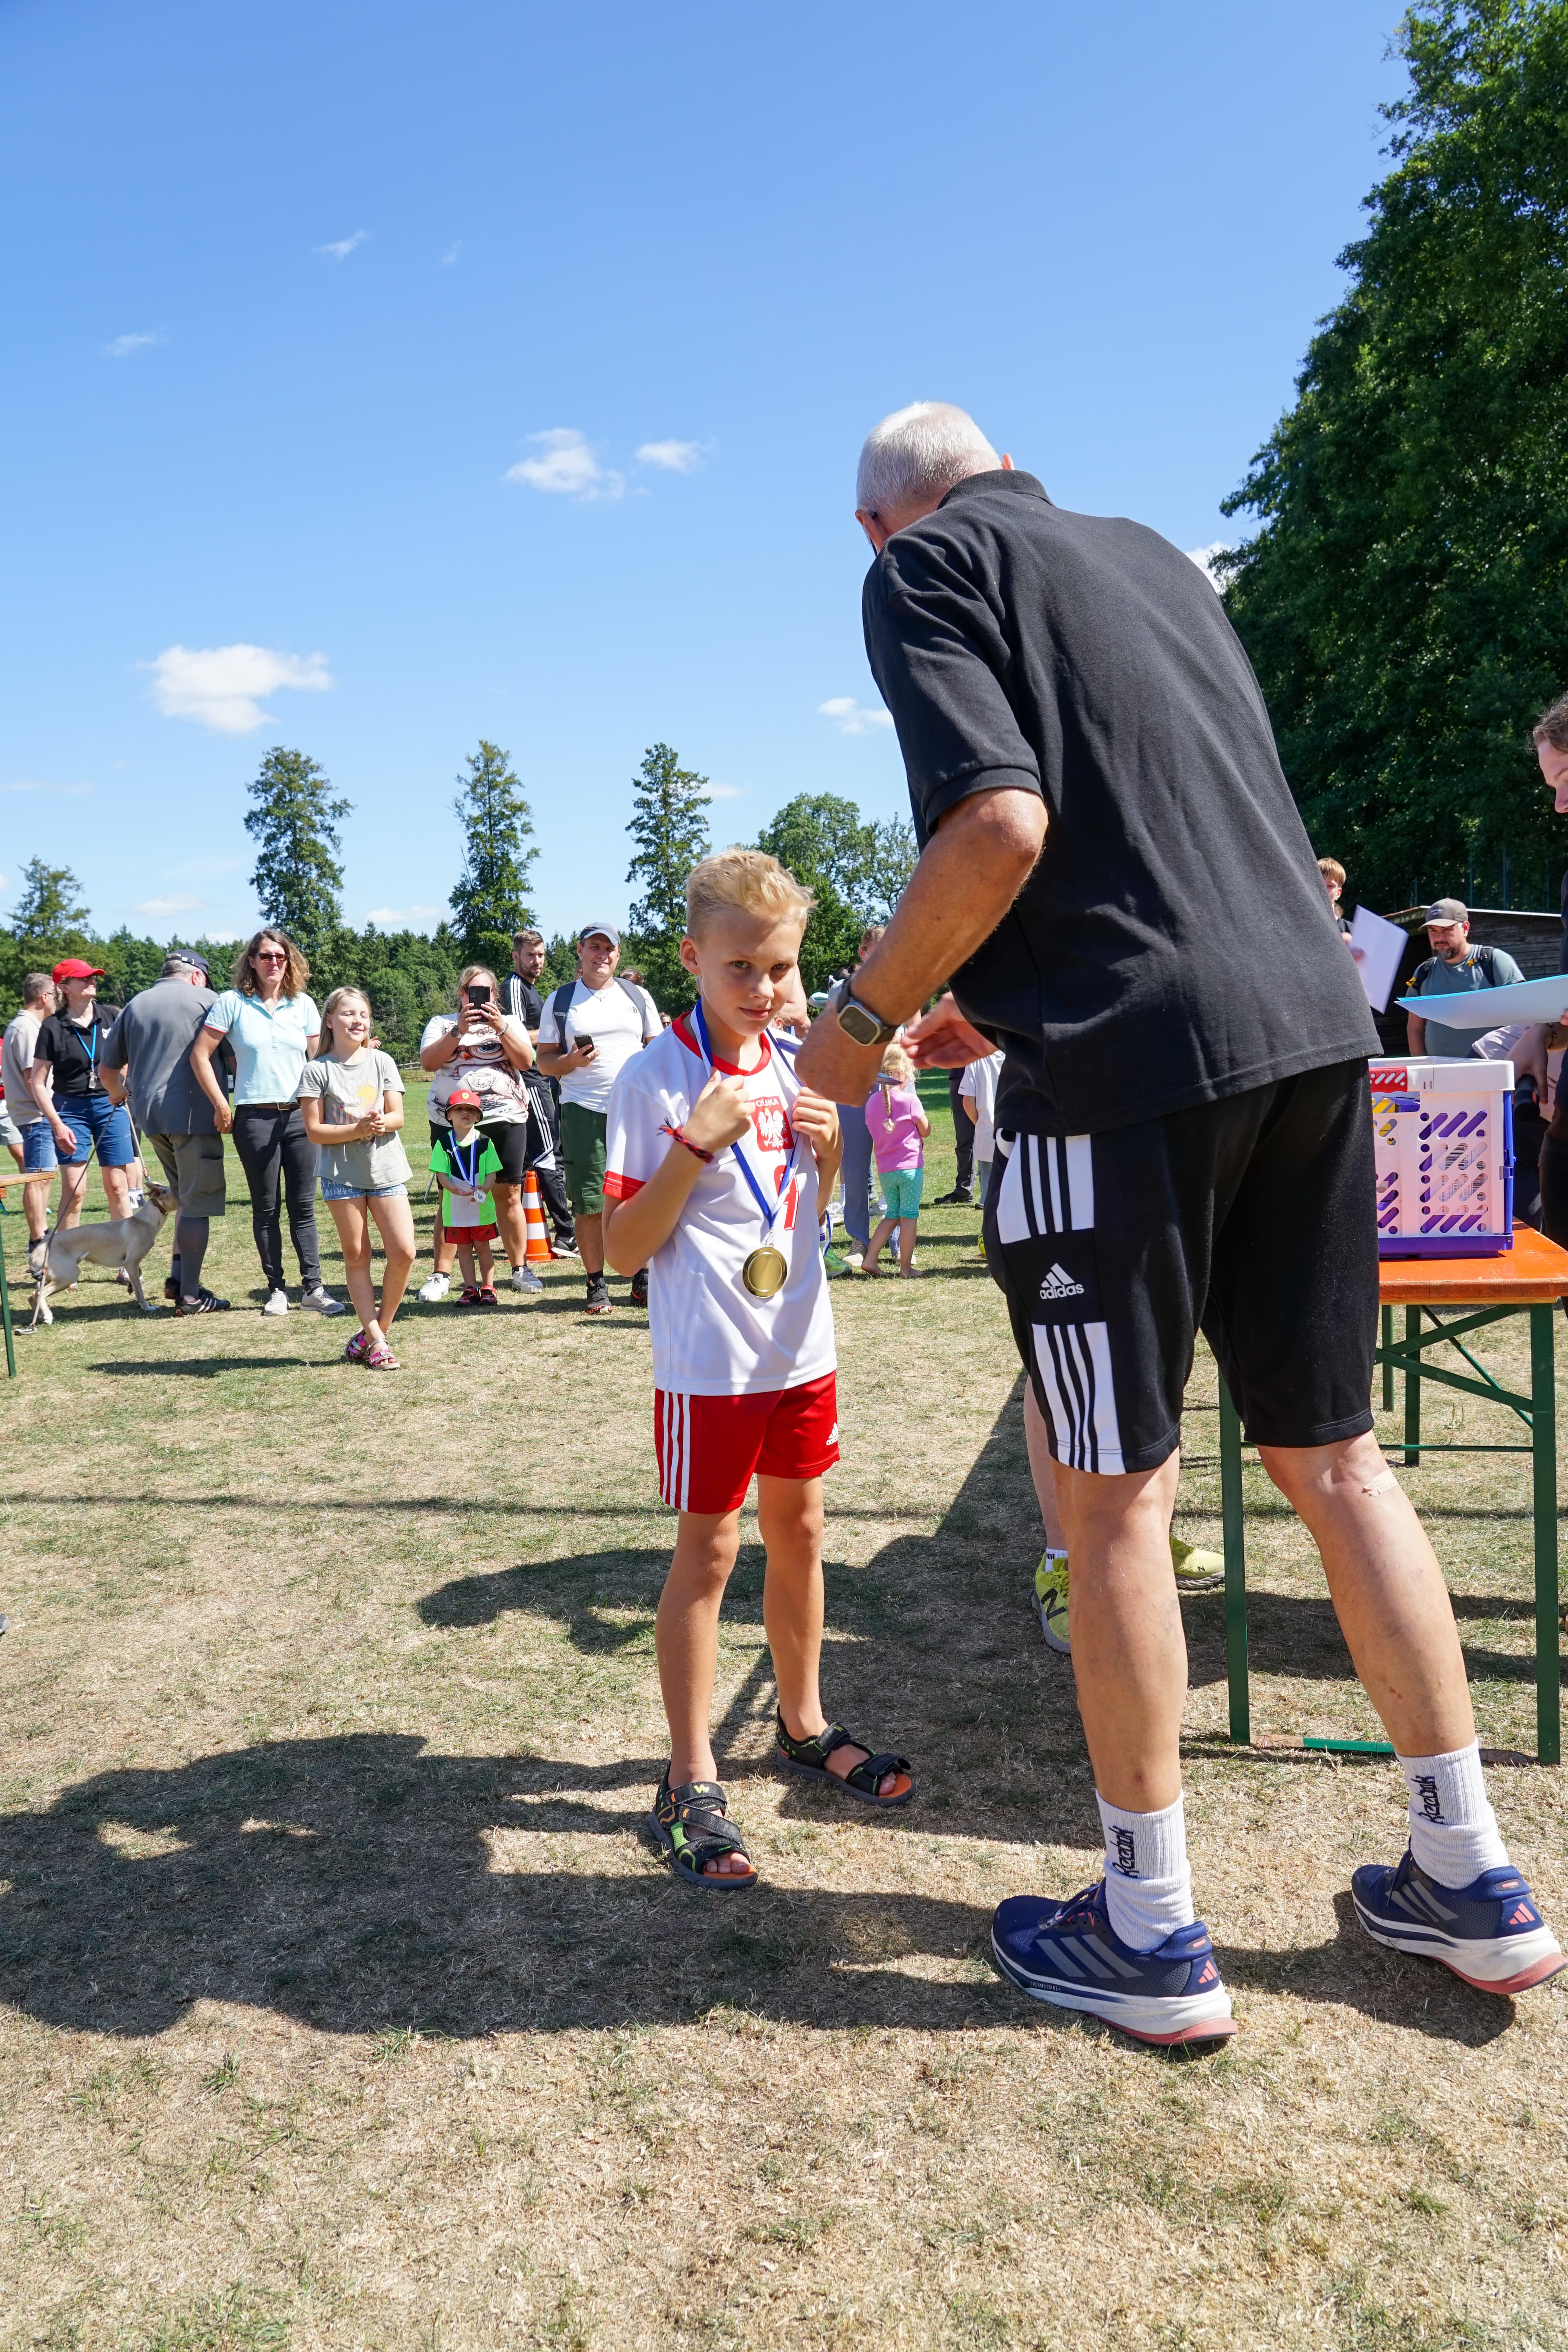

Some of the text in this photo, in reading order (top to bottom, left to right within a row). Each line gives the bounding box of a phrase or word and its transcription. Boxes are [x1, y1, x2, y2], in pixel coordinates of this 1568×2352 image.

[755, 1098, 780, 1107] OLSKA
[1040, 1284, 1085, 1299] adidas
[826, 1435, 838, 1446] adid
